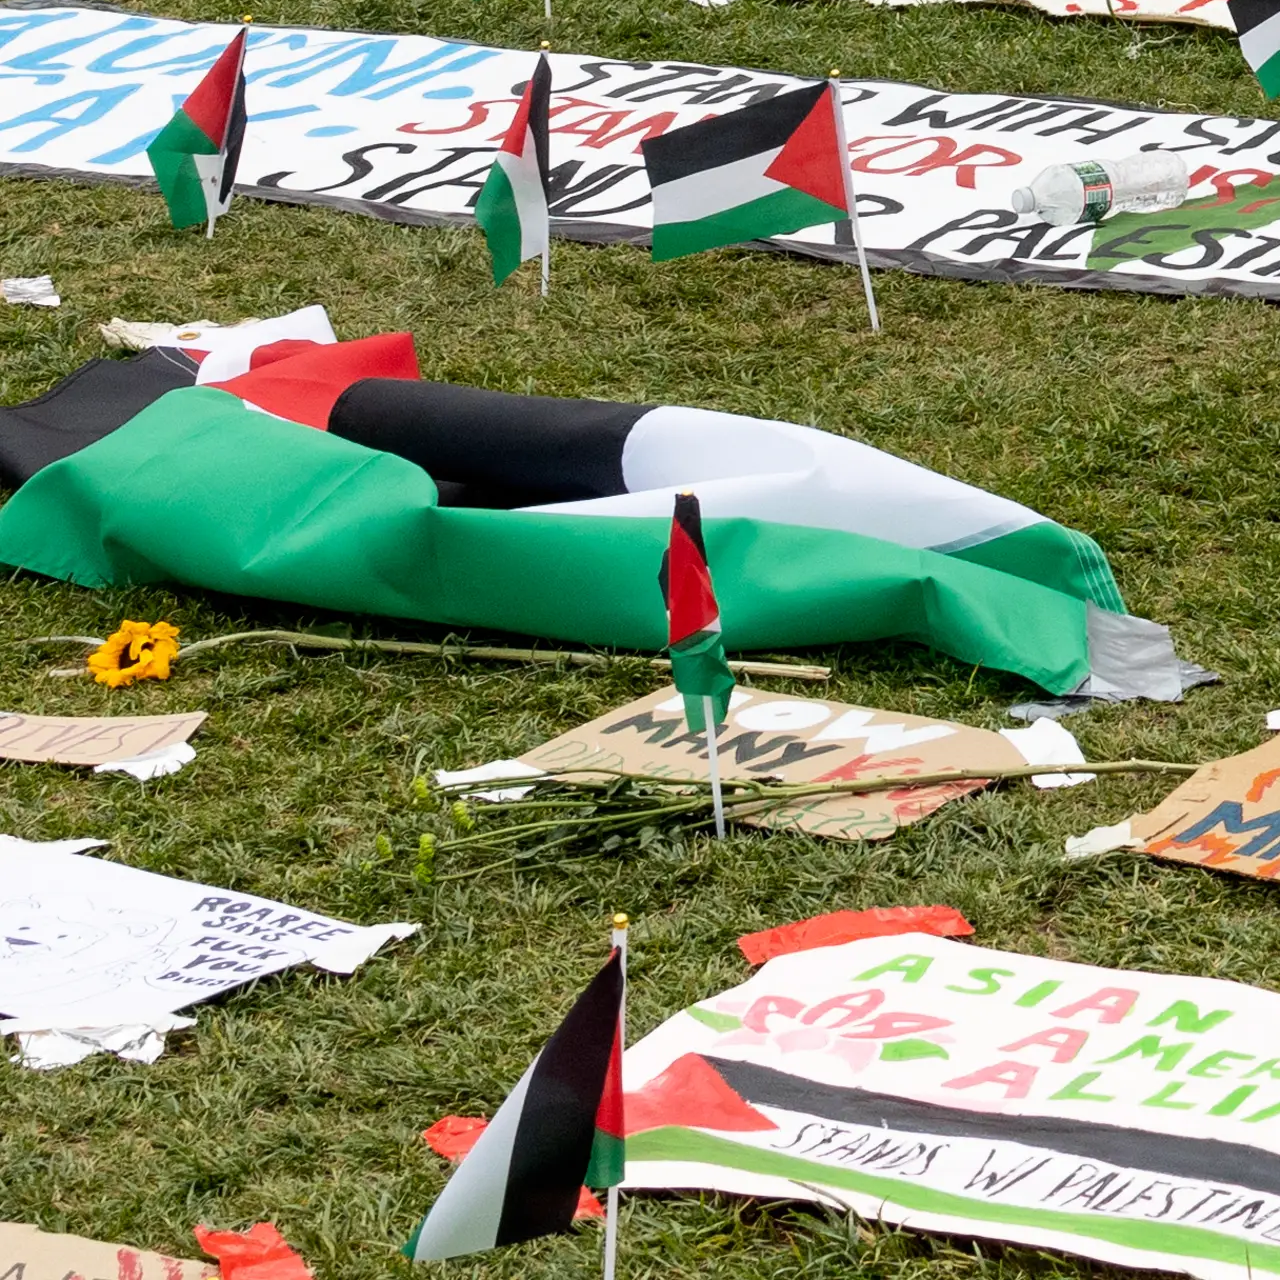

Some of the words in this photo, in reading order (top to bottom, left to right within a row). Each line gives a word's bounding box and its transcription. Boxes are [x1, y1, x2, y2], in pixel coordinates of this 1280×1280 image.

[885, 94, 1150, 146] WITH
[191, 897, 354, 941] ROAREE
[202, 915, 288, 942] SAYS
[190, 936, 288, 960] FUCK
[854, 953, 1235, 1035] ASIAN
[770, 1121, 952, 1180] STANDS
[963, 1149, 1019, 1197] W/
